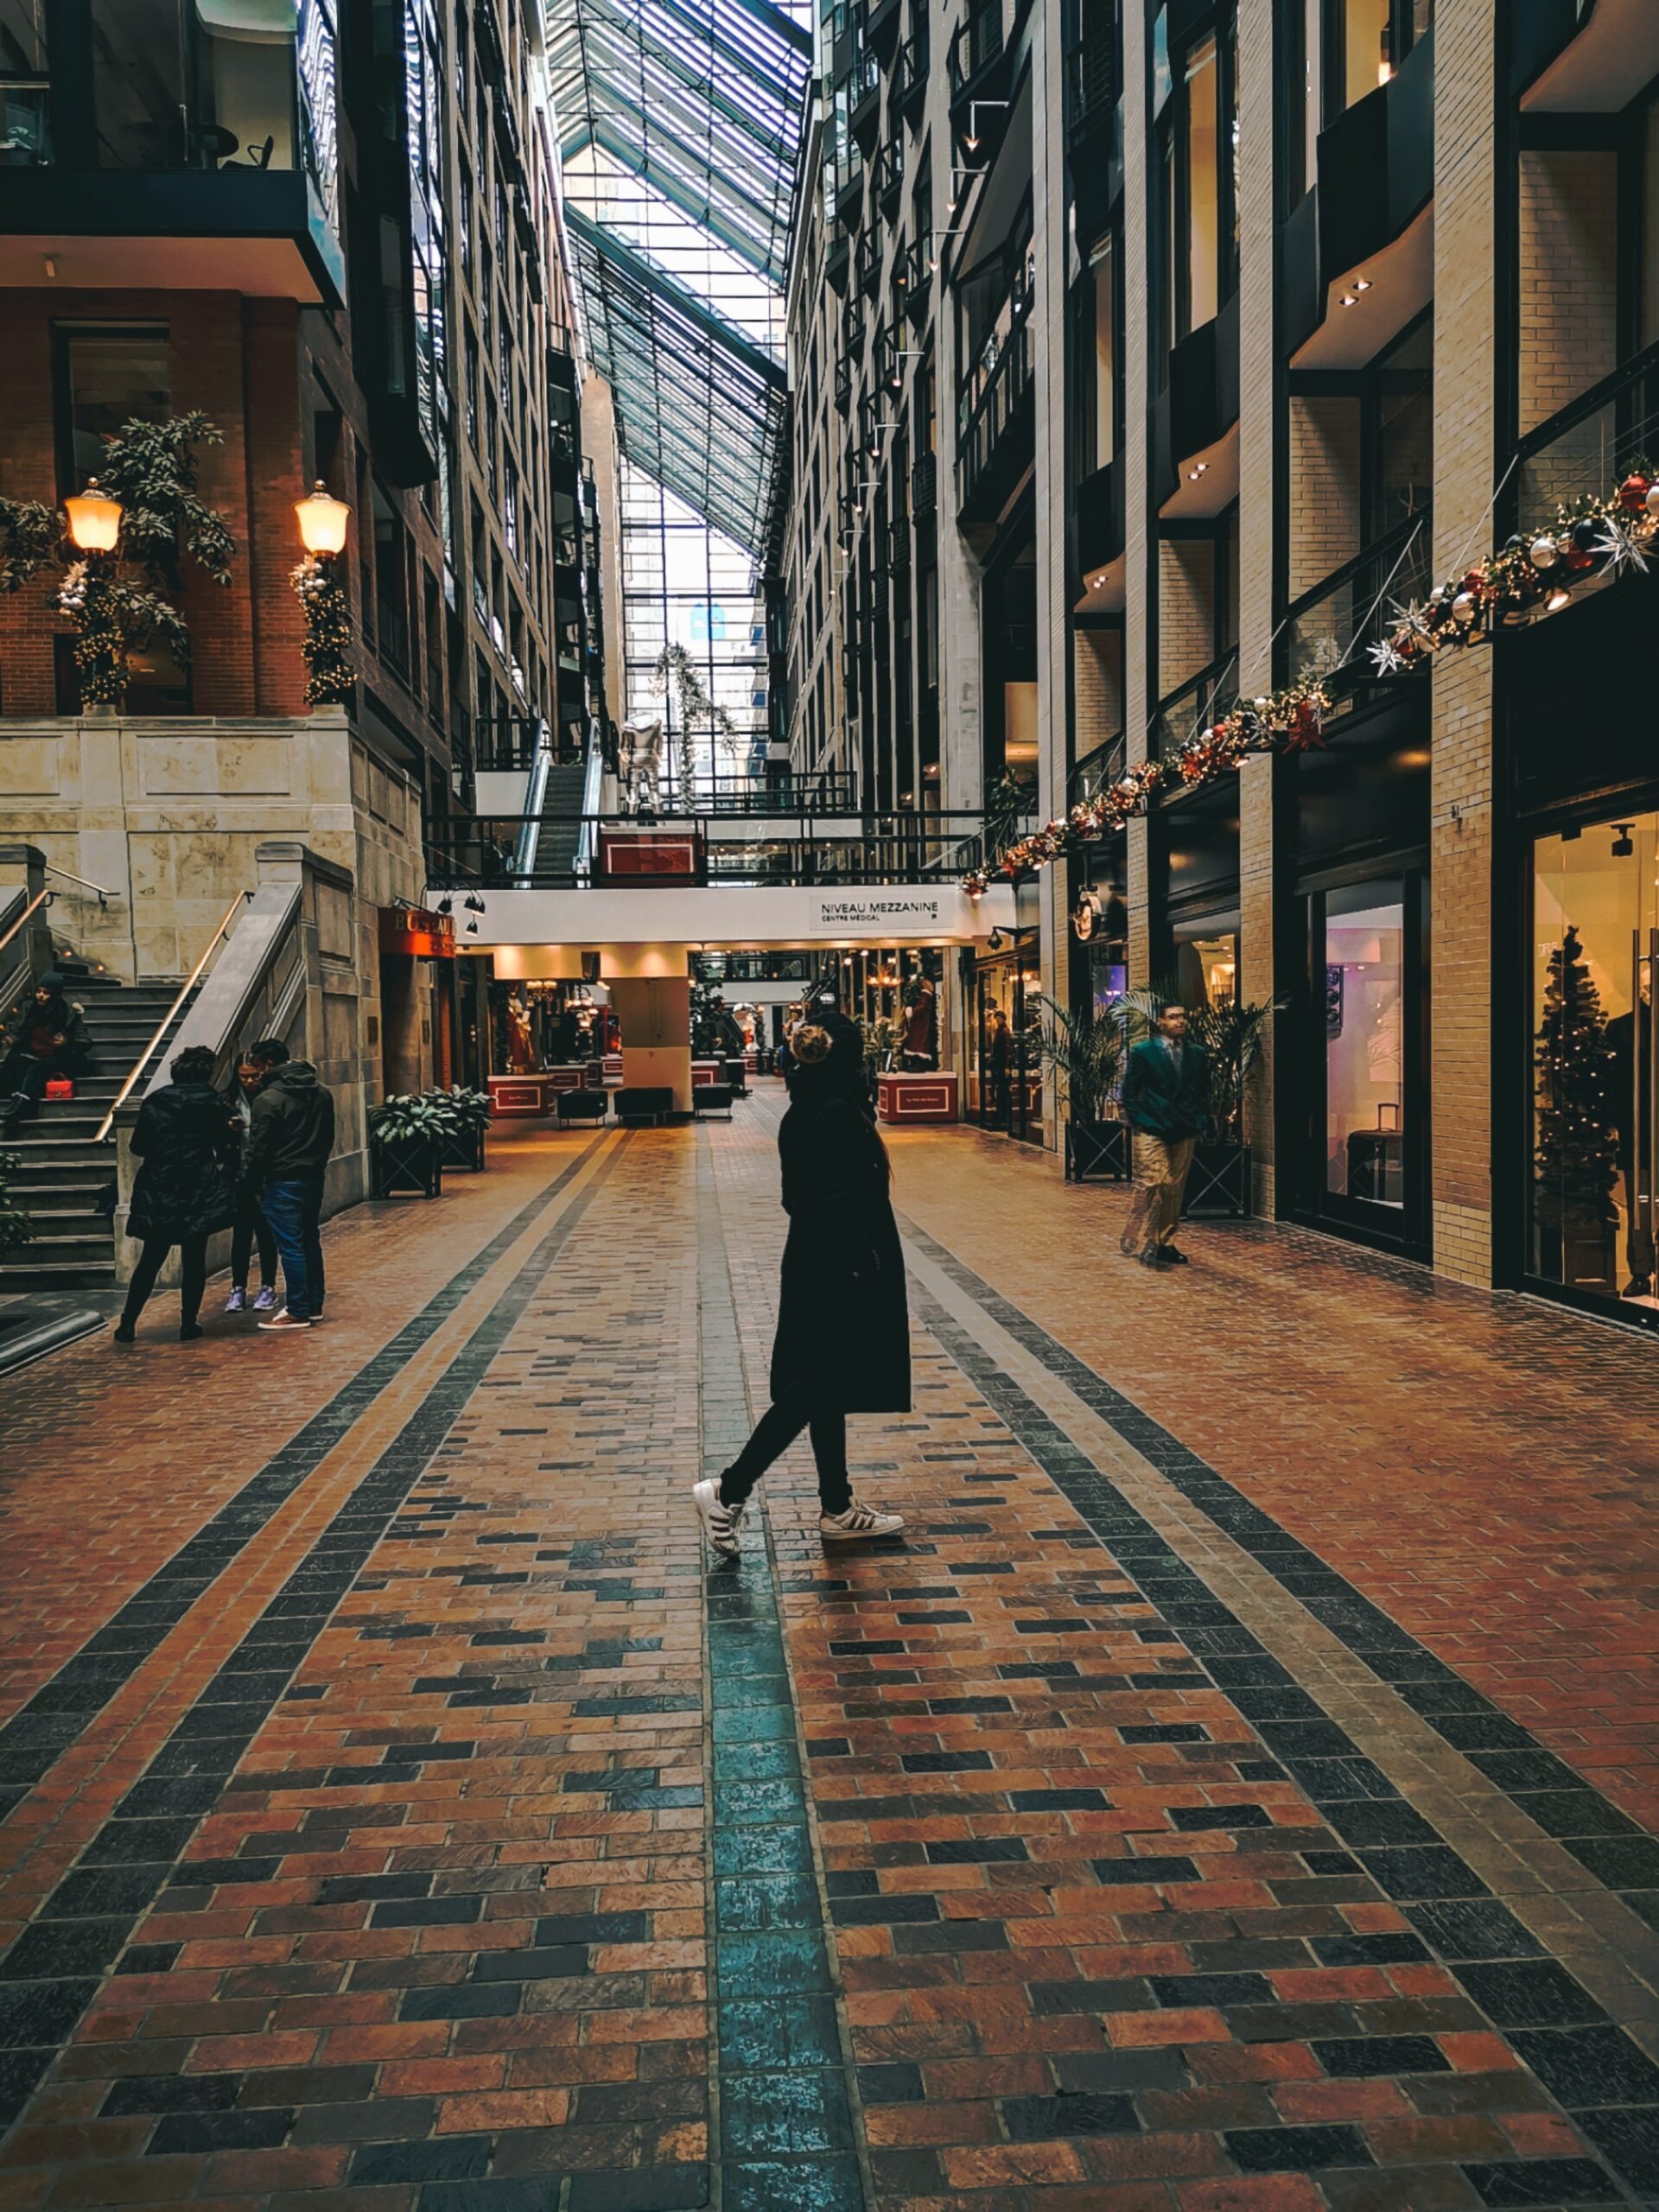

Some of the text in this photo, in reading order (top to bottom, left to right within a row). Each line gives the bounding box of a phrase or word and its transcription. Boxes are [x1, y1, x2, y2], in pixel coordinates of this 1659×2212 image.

[822, 901, 938, 913] NIVEAU MEZZANINE
[396, 912, 450, 936] BUAU
